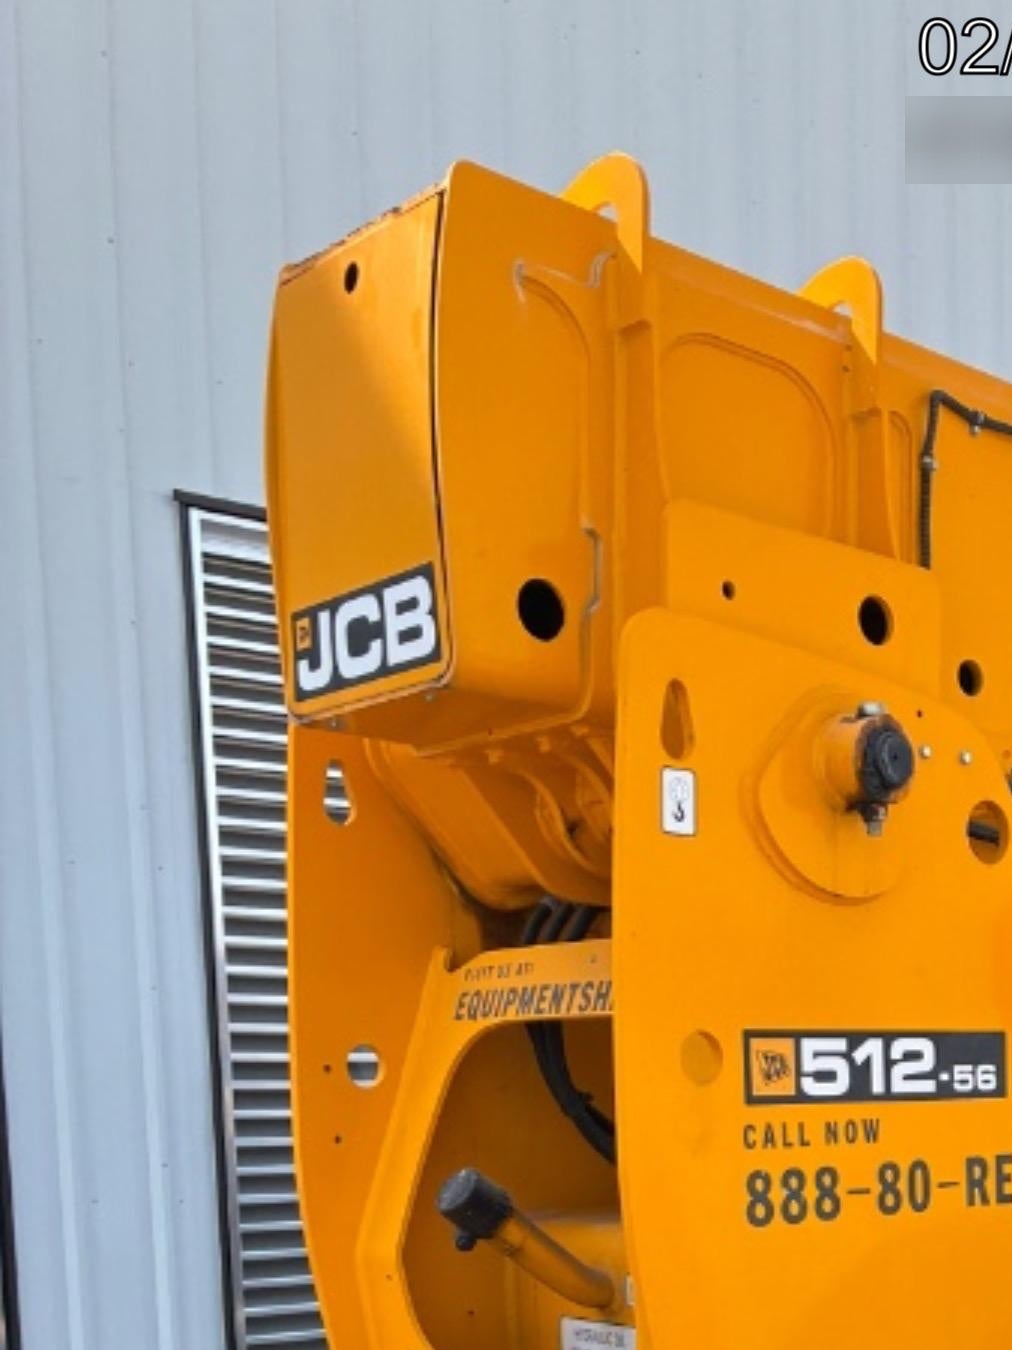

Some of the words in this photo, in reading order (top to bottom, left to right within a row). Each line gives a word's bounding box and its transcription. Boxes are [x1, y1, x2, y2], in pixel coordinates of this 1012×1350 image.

[297, 575, 437, 691] JCB
[454, 979, 614, 1021] EQUIPMENTSH
[743, 1121, 811, 1150] CALL
[824, 1118, 882, 1144] NOW
